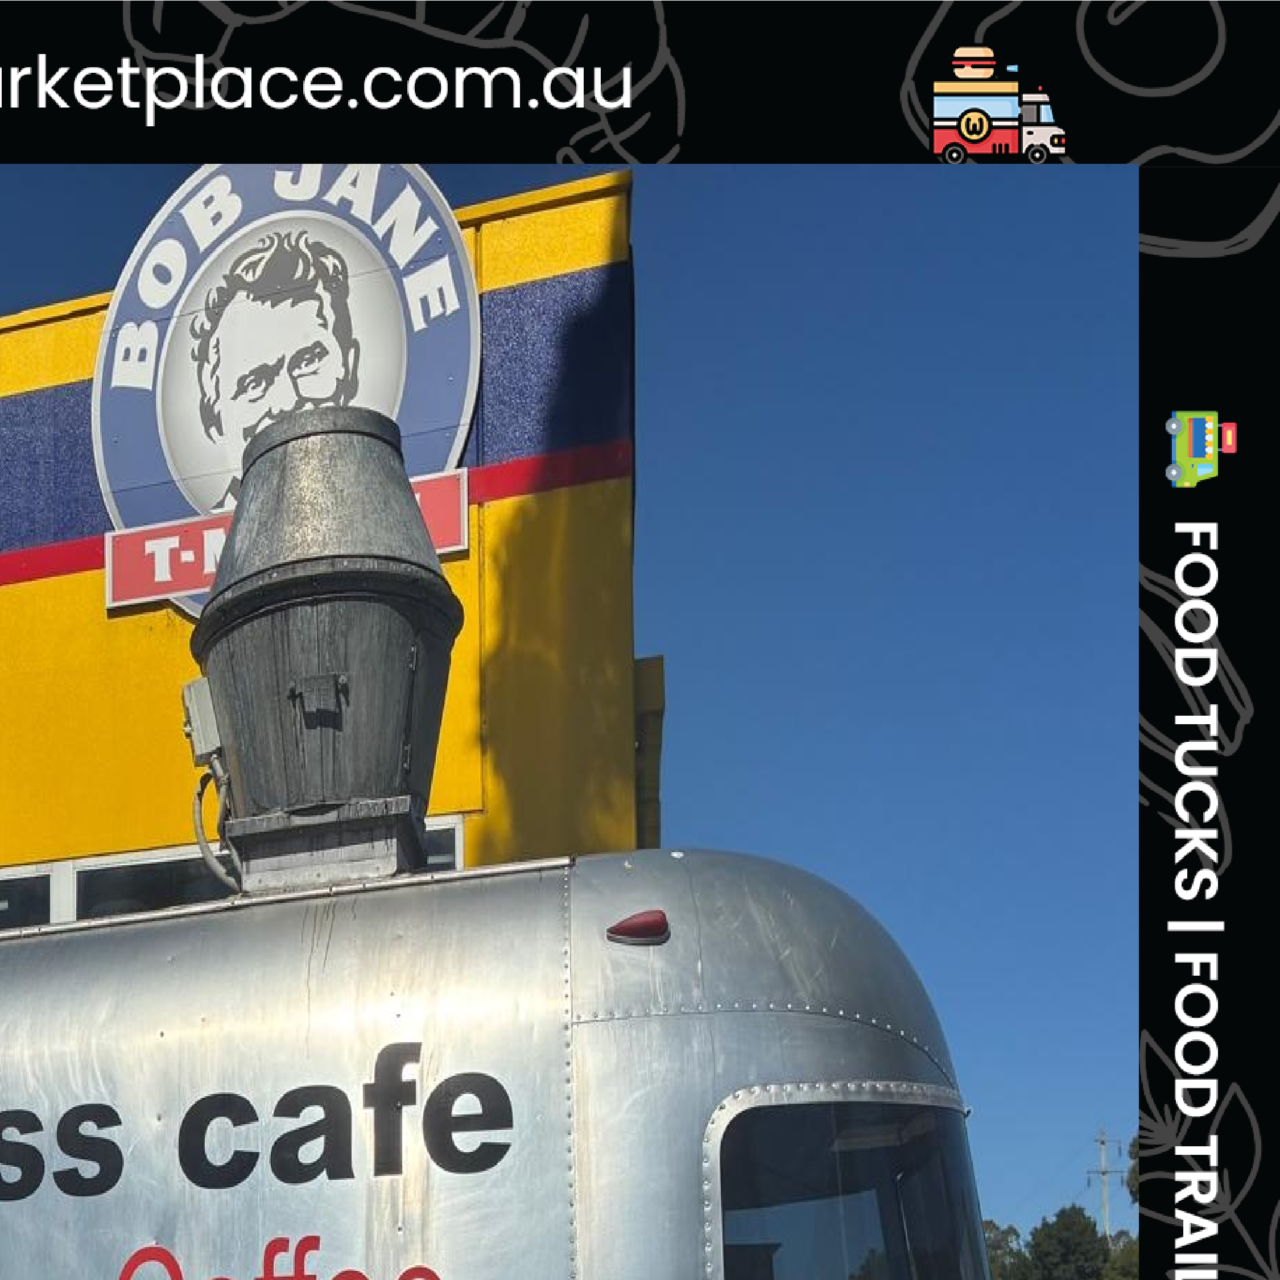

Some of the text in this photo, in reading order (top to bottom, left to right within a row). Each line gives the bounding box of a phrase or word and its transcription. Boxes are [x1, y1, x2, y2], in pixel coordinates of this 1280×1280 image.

[112, 164, 460, 391] BOB JANE
[178, 1042, 513, 1189] cafe
